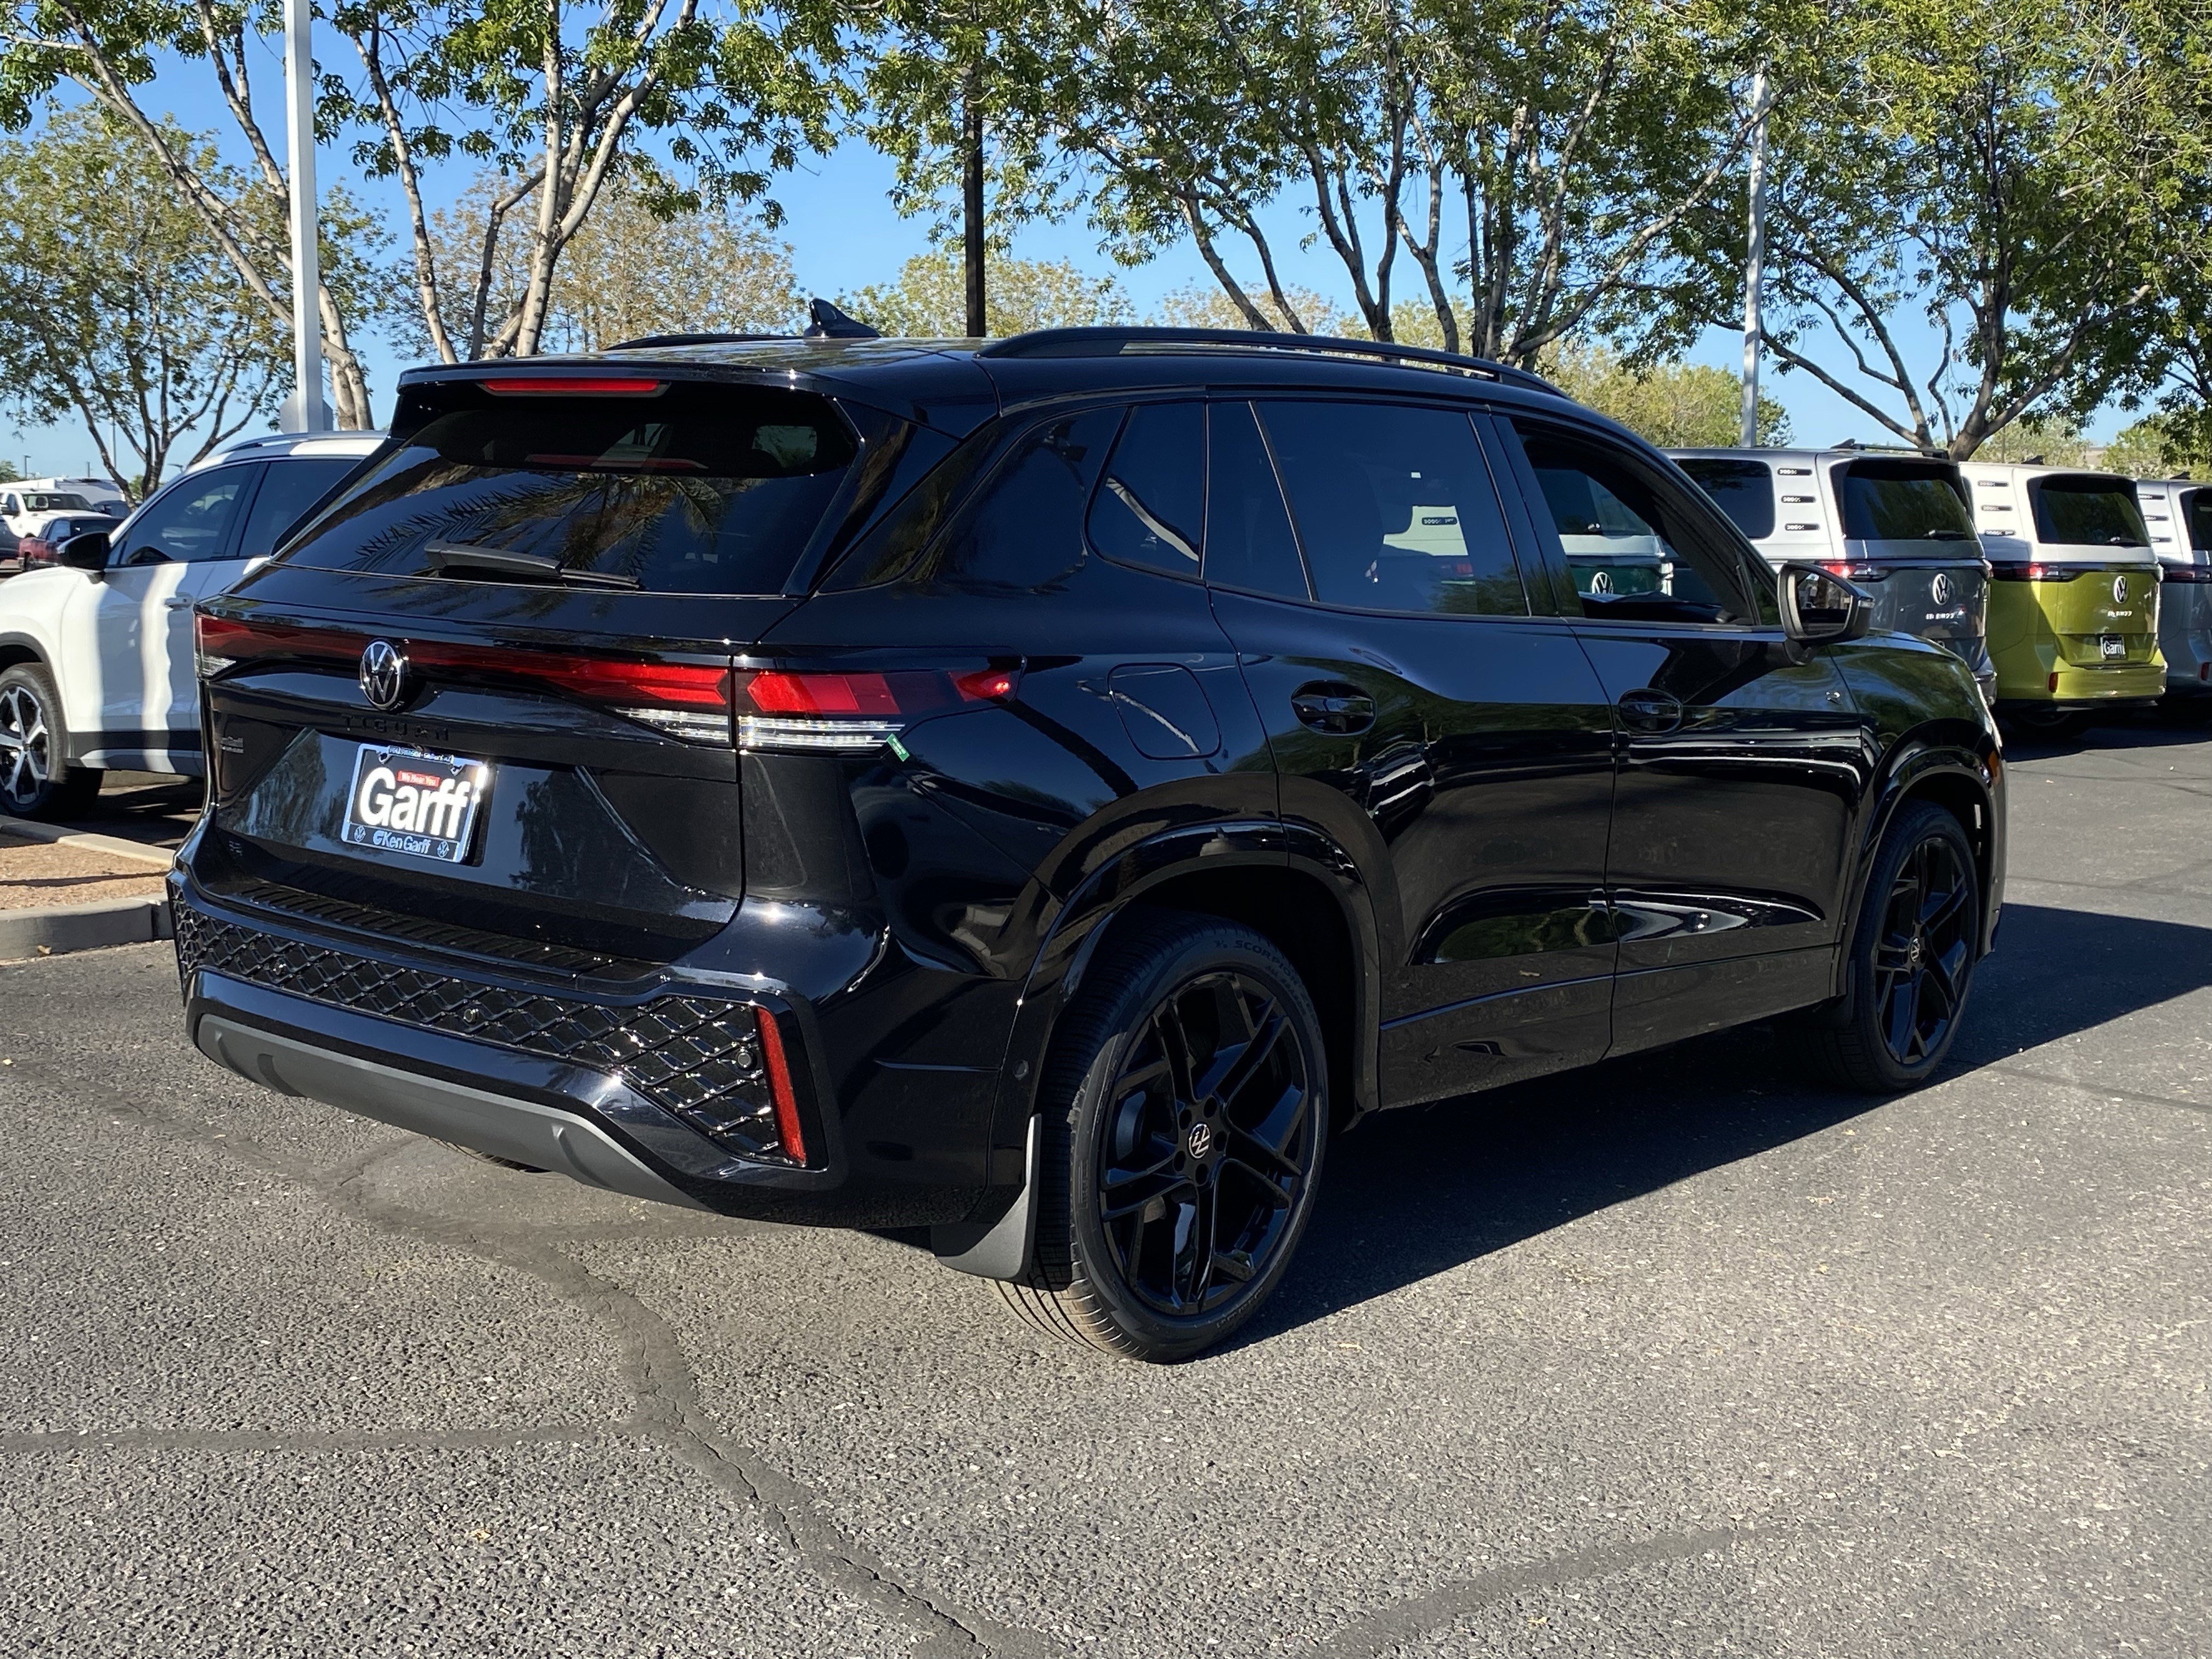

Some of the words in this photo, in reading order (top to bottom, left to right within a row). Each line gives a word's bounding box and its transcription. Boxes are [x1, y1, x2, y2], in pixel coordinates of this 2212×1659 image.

[342, 714, 449, 741] TIGUAN
[360, 767, 471, 838] Garff
[381, 832, 403, 849] Ken
[403, 836, 431, 854] Garff
